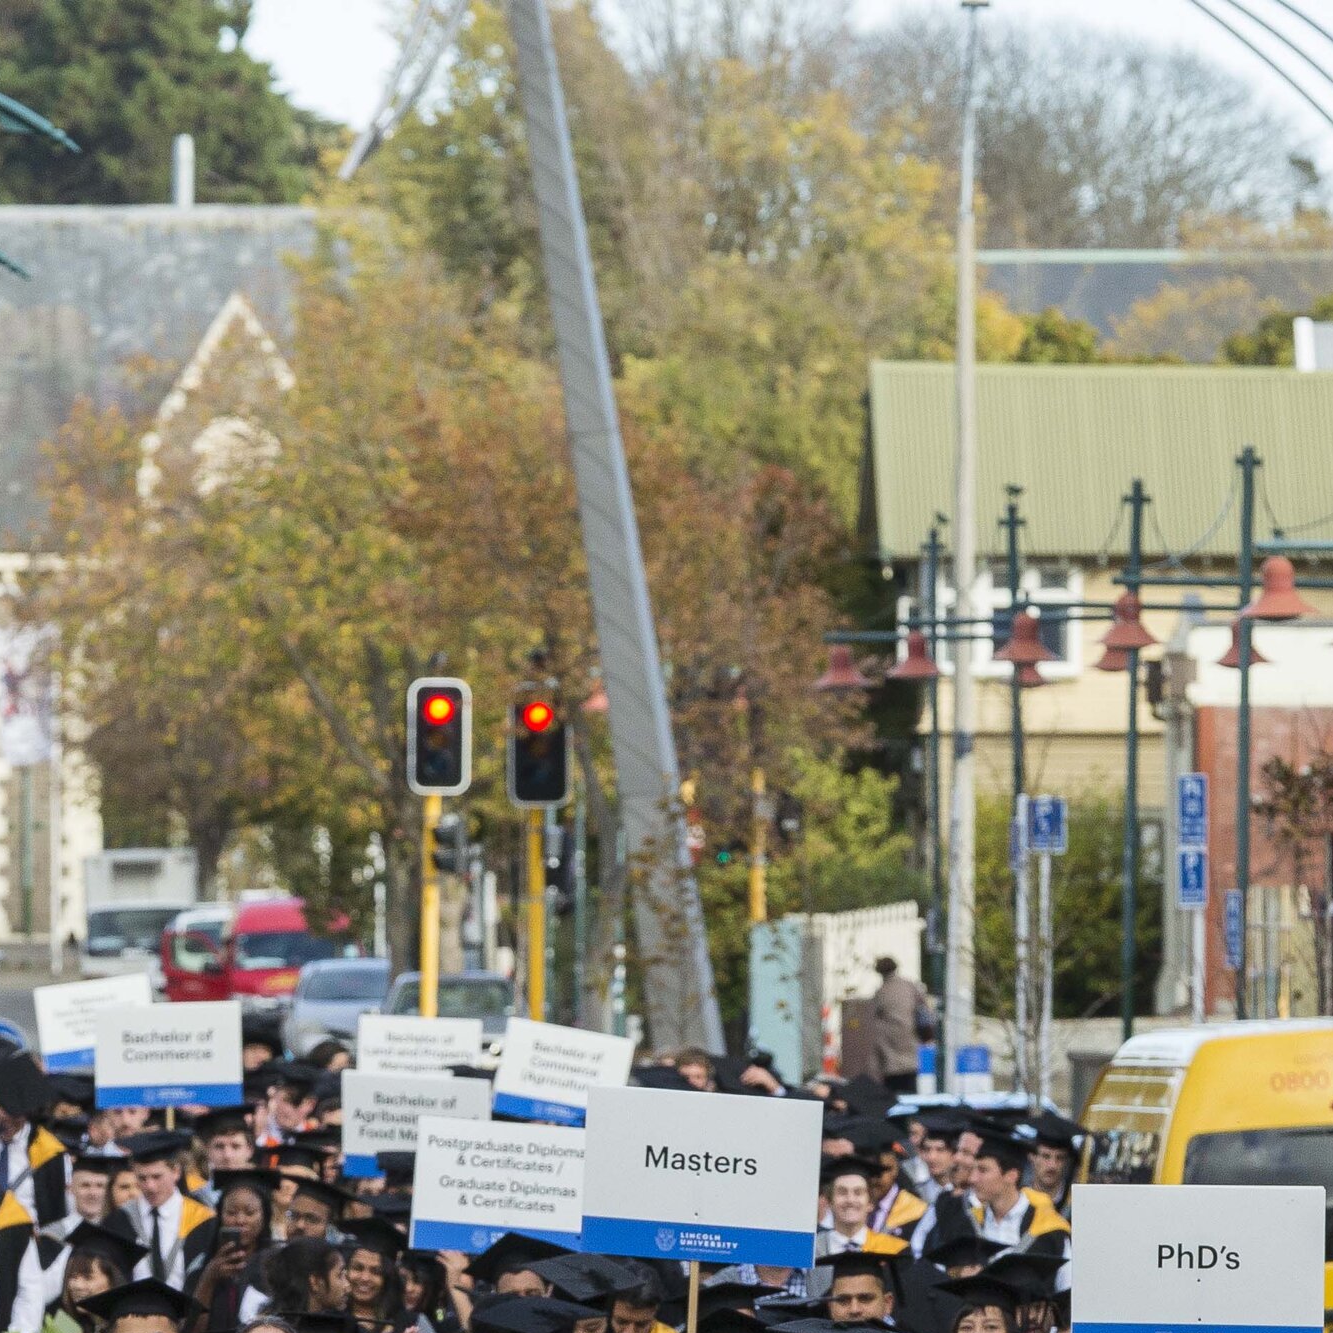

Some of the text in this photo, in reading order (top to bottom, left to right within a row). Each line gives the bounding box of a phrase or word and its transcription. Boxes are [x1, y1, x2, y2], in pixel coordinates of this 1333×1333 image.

[428, 1134, 524, 1154] Postgraduate
[470, 1154, 554, 1173] Certificates
[645, 1144, 758, 1176] Masters
[439, 1174, 578, 1198] Graduate Diplomas
[472, 1194, 556, 1212] Certificates
[679, 1231, 722, 1241] LINCOLN
[679, 1238, 739, 1250] UNIVERSITY
[1157, 1243, 1241, 1270] PhD's
